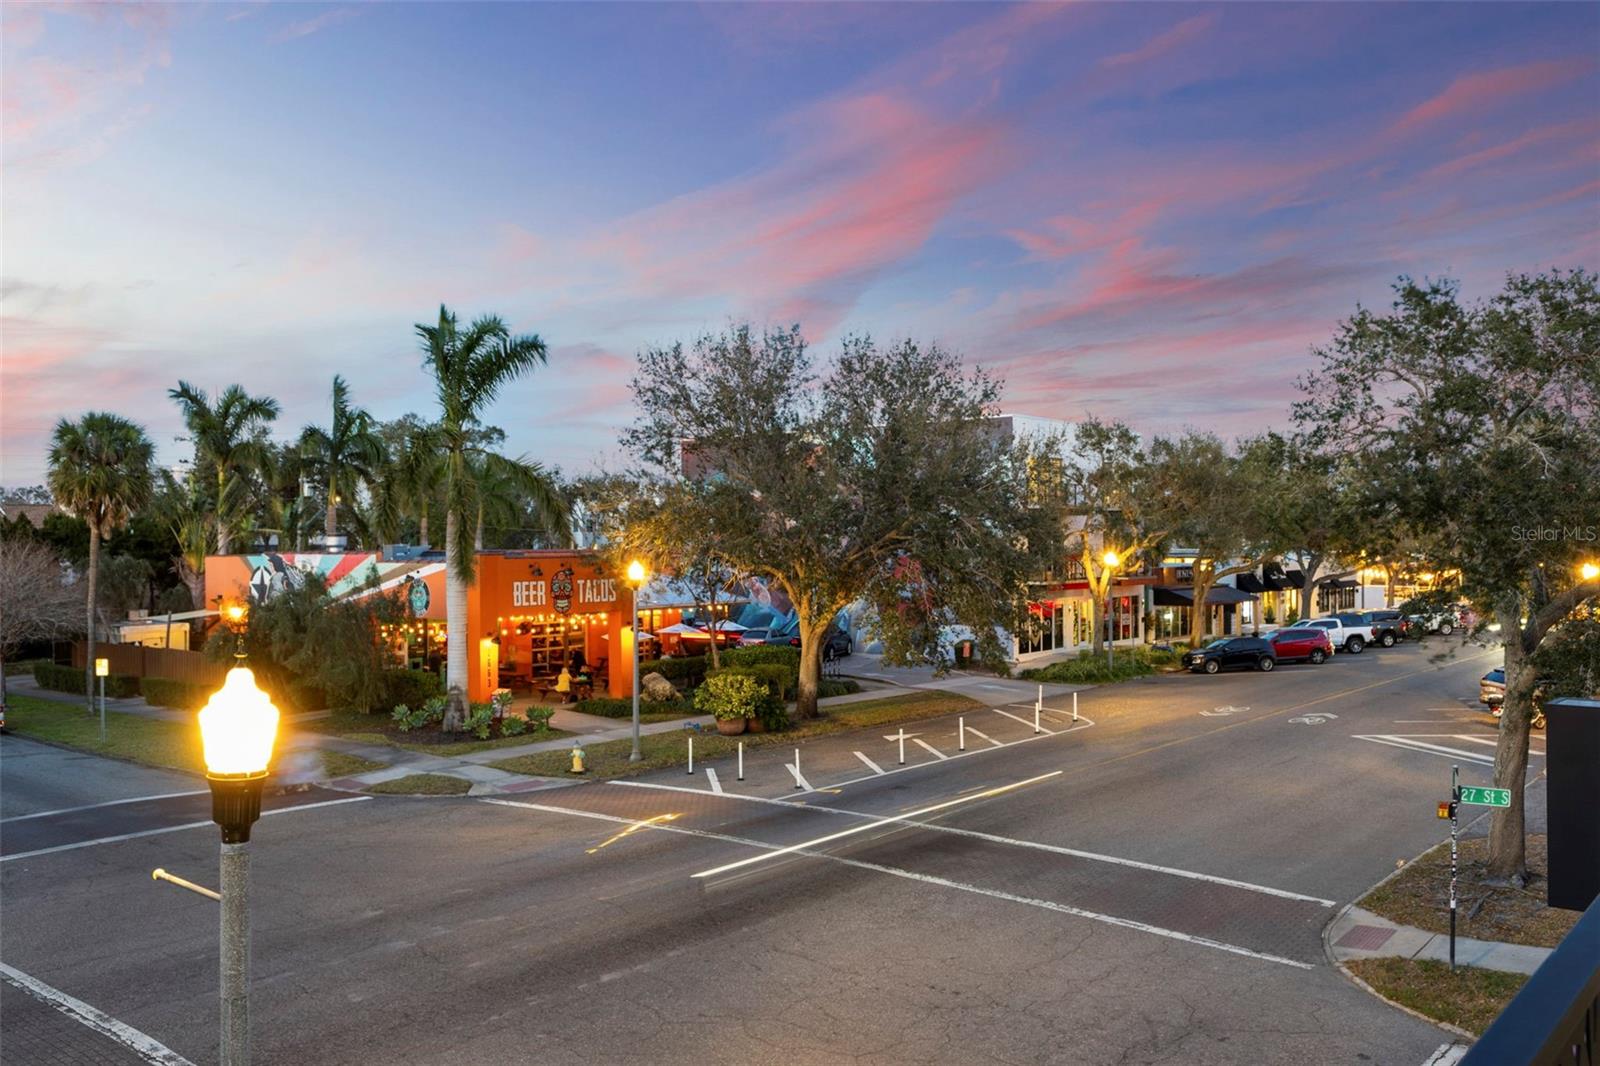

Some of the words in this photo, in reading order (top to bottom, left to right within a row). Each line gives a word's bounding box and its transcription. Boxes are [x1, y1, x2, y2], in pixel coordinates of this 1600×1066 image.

[513, 581, 546, 606] BEER
[577, 579, 616, 603] TACOS
[1461, 788, 1476, 801] 27
[1483, 790, 1495, 803] St
[1501, 792, 1509, 804] S
